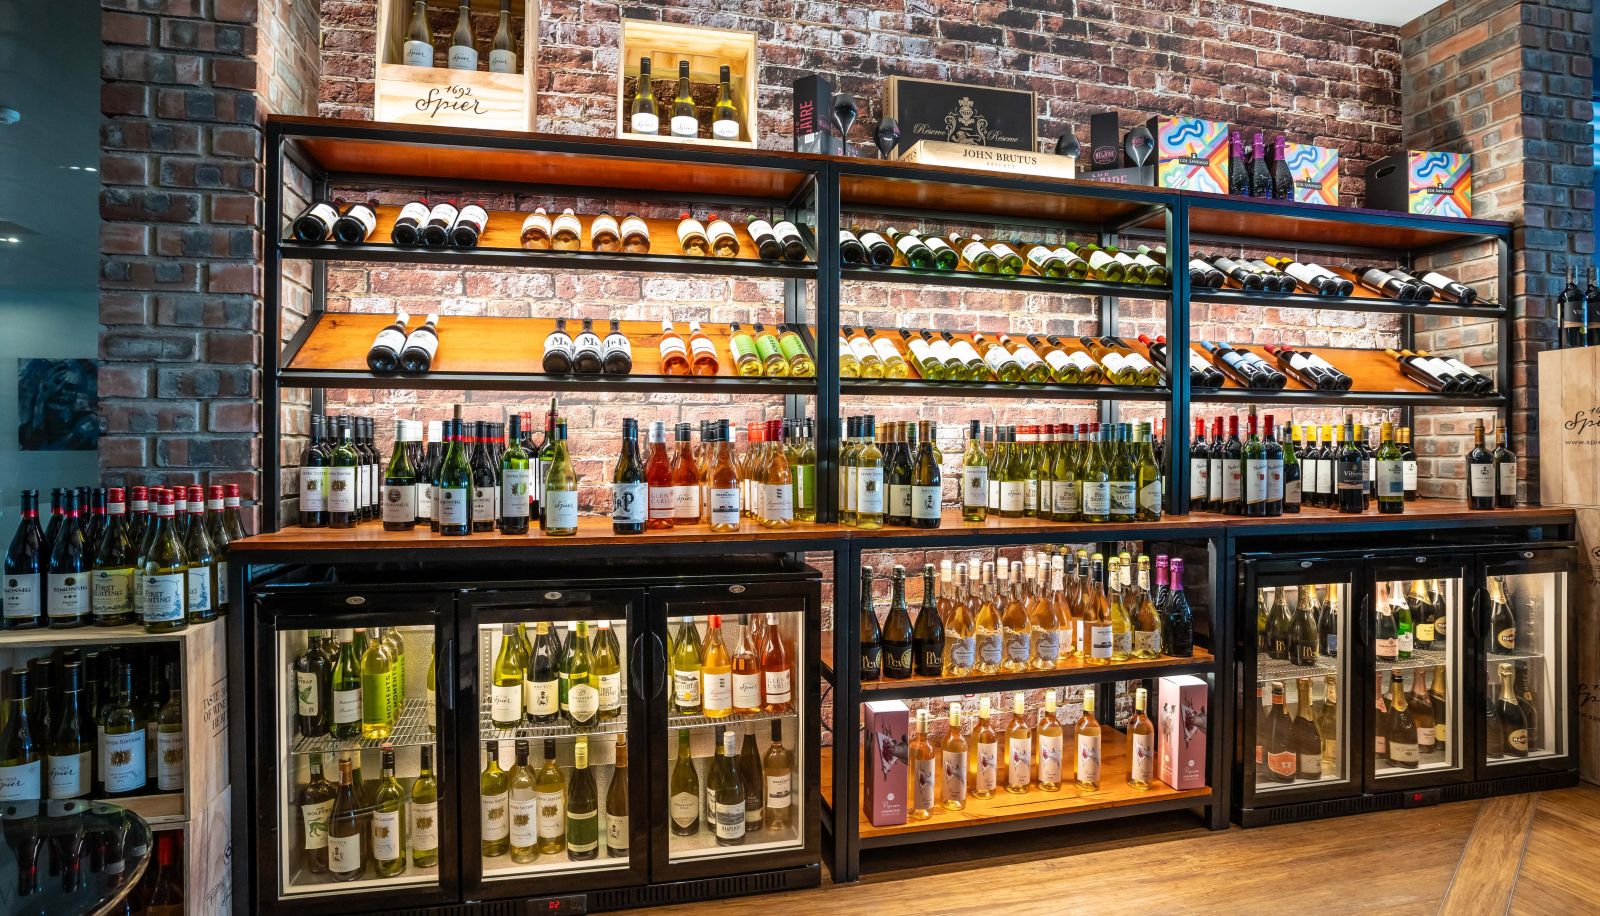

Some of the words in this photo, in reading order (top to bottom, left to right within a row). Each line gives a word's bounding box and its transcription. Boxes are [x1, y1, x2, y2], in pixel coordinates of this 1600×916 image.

[453, 53, 472, 63] Spier
[444, 84, 473, 99] 1692
[415, 88, 489, 118] Spier
[962, 149, 993, 160] JOHN
[996, 153, 1038, 166] BRUTUS
[52, 585, 88, 593] SIMONSIG
